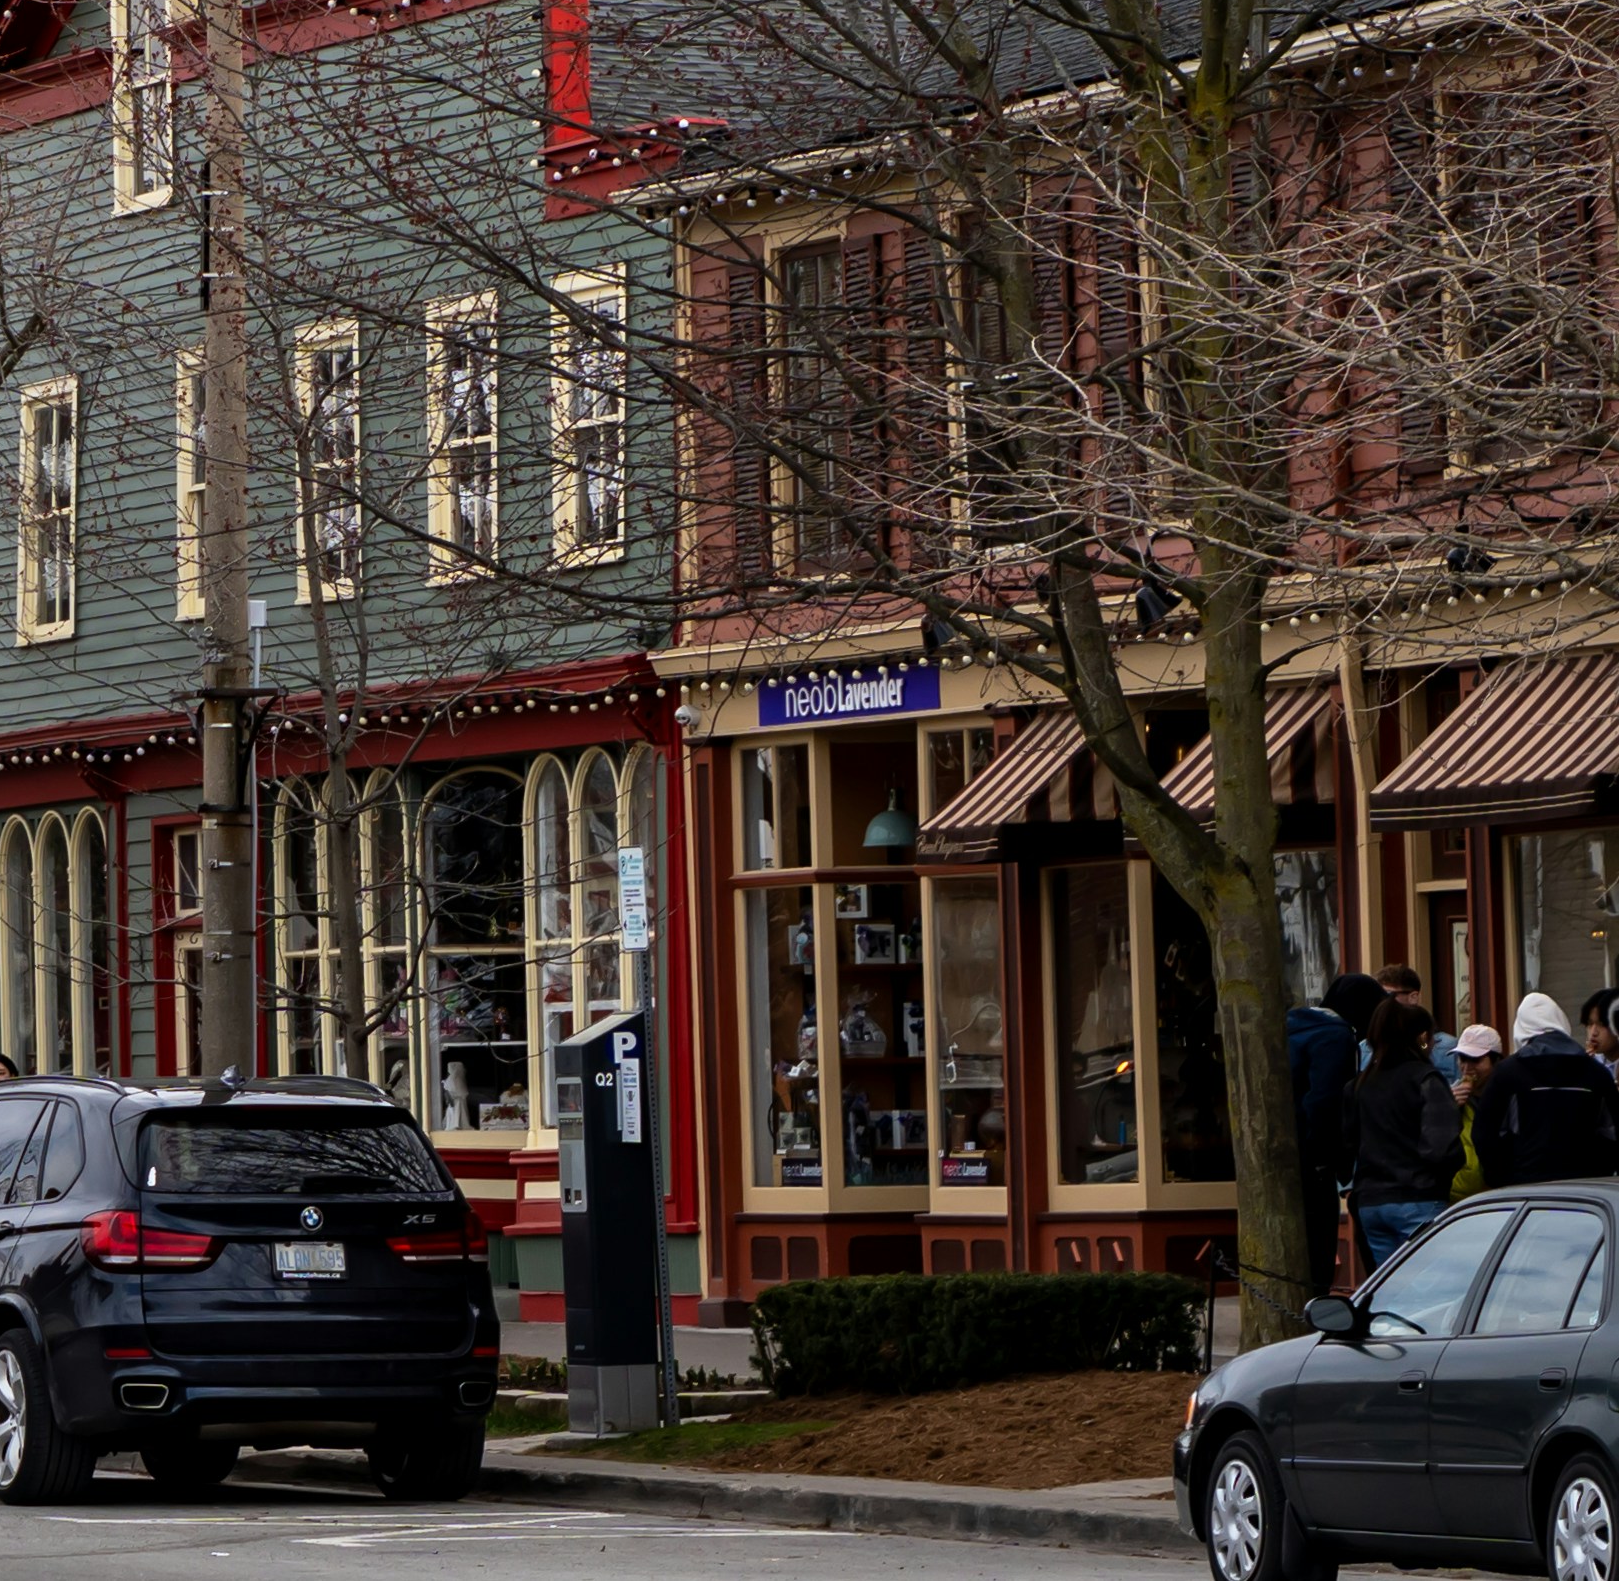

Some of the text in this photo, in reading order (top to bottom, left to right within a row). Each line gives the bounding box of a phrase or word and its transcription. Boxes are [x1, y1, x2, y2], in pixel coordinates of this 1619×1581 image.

[613, 1031, 637, 1064] P
[595, 1072, 614, 1087] Q2
[403, 1214, 437, 1225] X5
